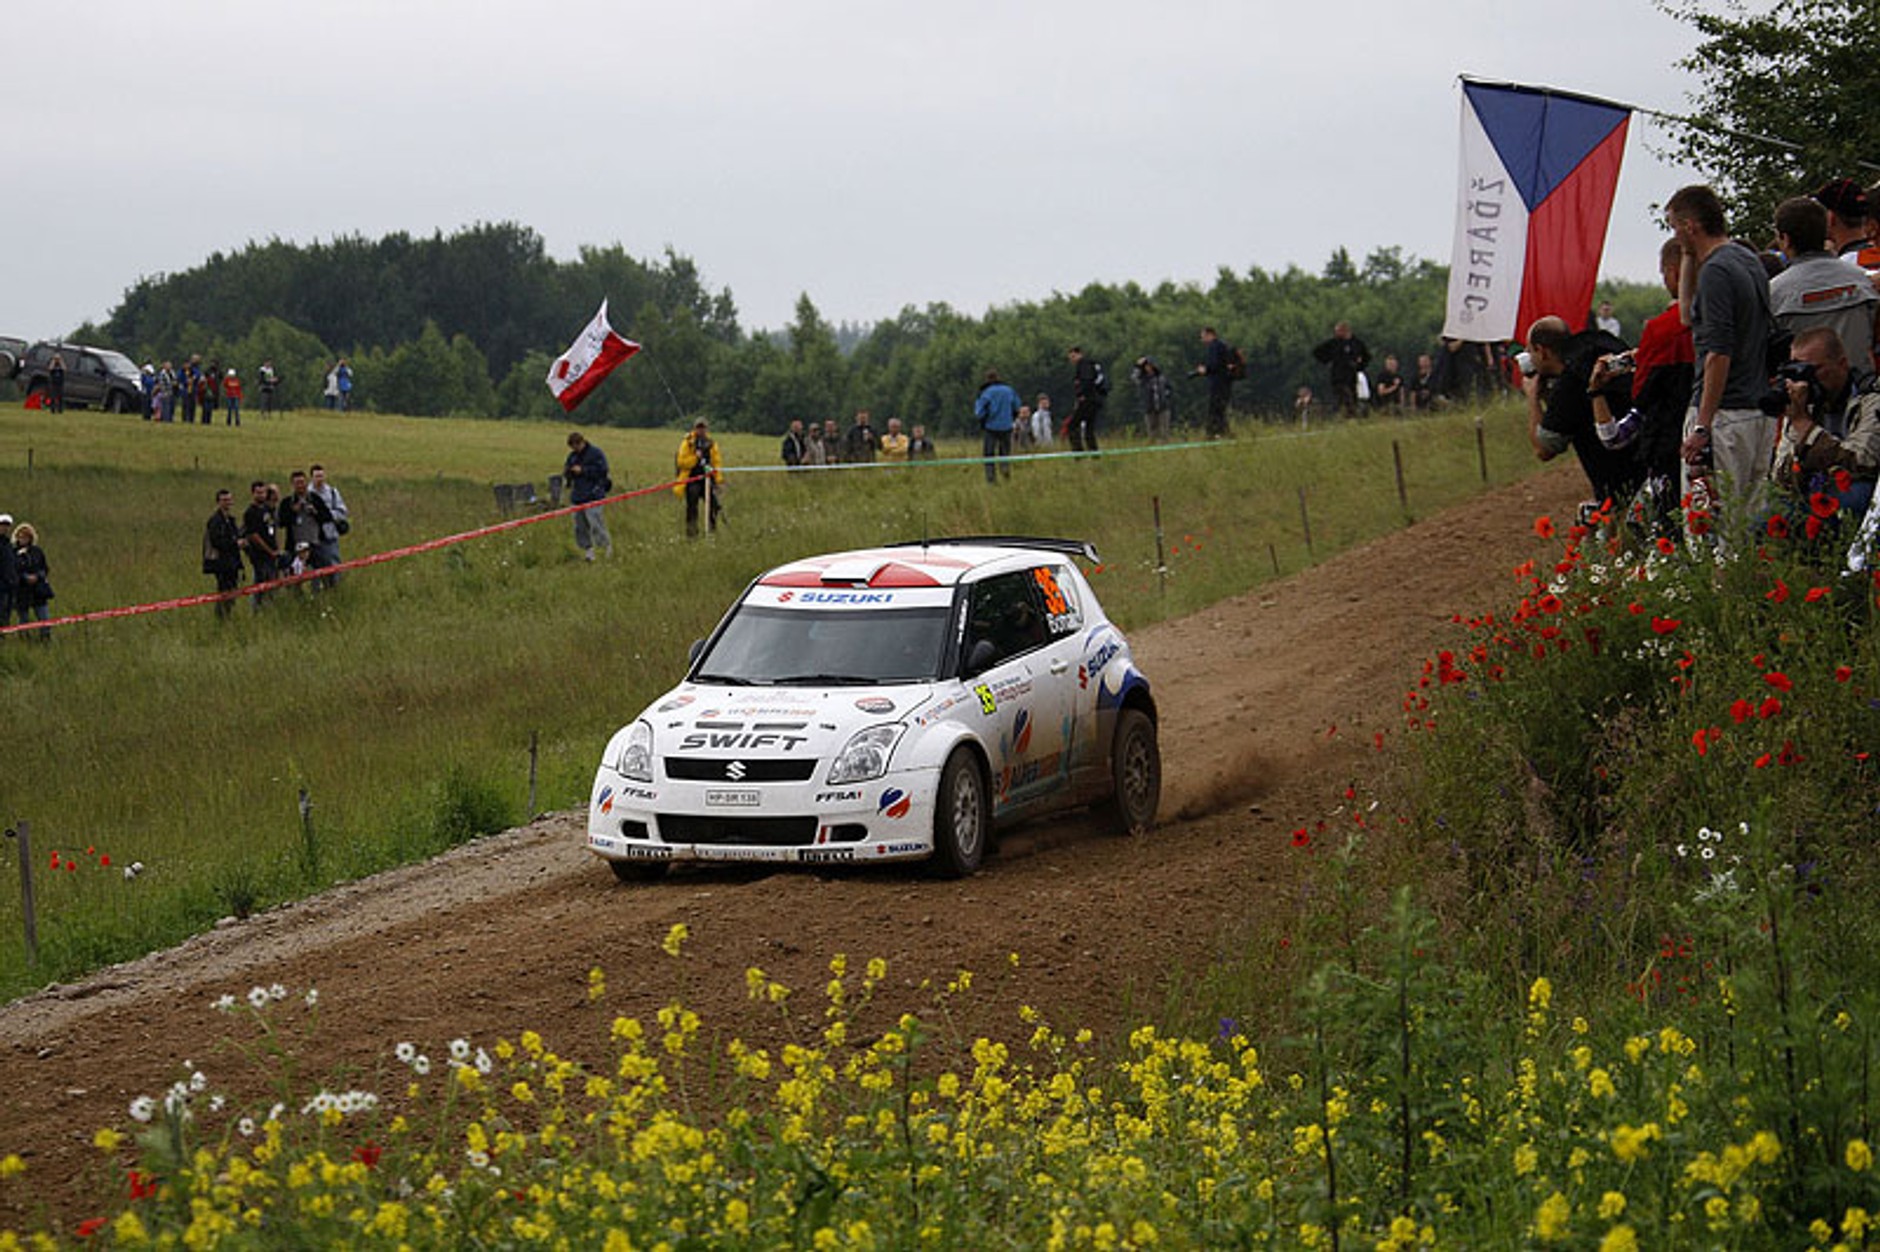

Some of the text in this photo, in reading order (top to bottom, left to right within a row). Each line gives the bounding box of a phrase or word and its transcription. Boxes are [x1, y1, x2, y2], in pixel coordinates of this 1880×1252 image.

[800, 592, 893, 603] SUZUKI
[679, 733, 808, 751] SWIFT
[888, 843, 927, 853] SUZUKI
